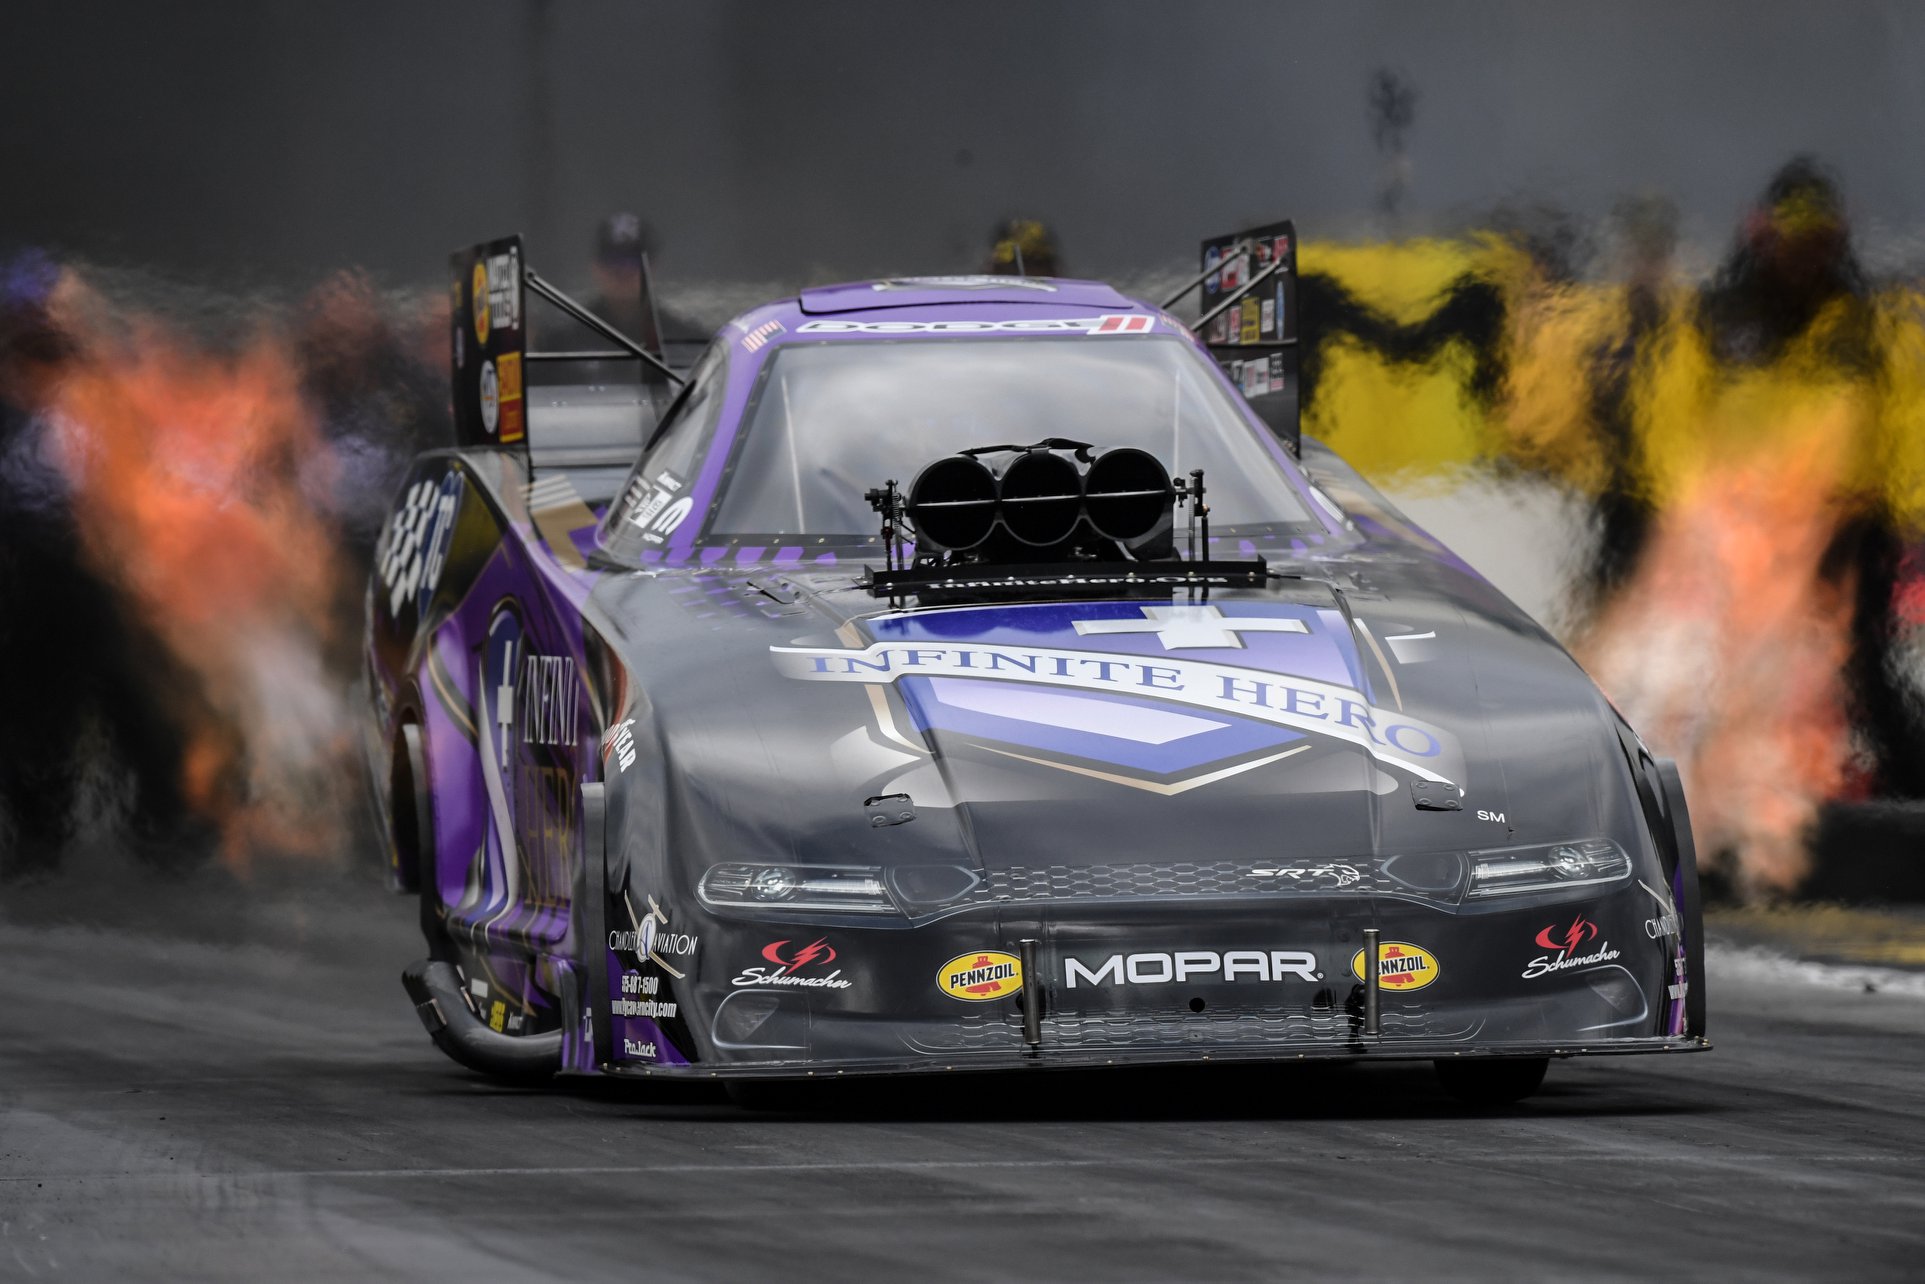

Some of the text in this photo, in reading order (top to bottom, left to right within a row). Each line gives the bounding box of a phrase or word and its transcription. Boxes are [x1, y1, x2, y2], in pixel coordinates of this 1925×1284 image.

[806, 647, 1443, 758] INFINITE HERO
[1477, 810, 1505, 823] SM
[1246, 868, 1336, 880] SRT
[653, 932, 698, 955] AVIATION
[1064, 951, 1319, 988] MOPAR
[1378, 956, 1427, 975] NNZOIL
[1522, 941, 1620, 979] Schumacher
[732, 966, 852, 989] Schumacher
[950, 961, 1016, 988] PENNZOIL
